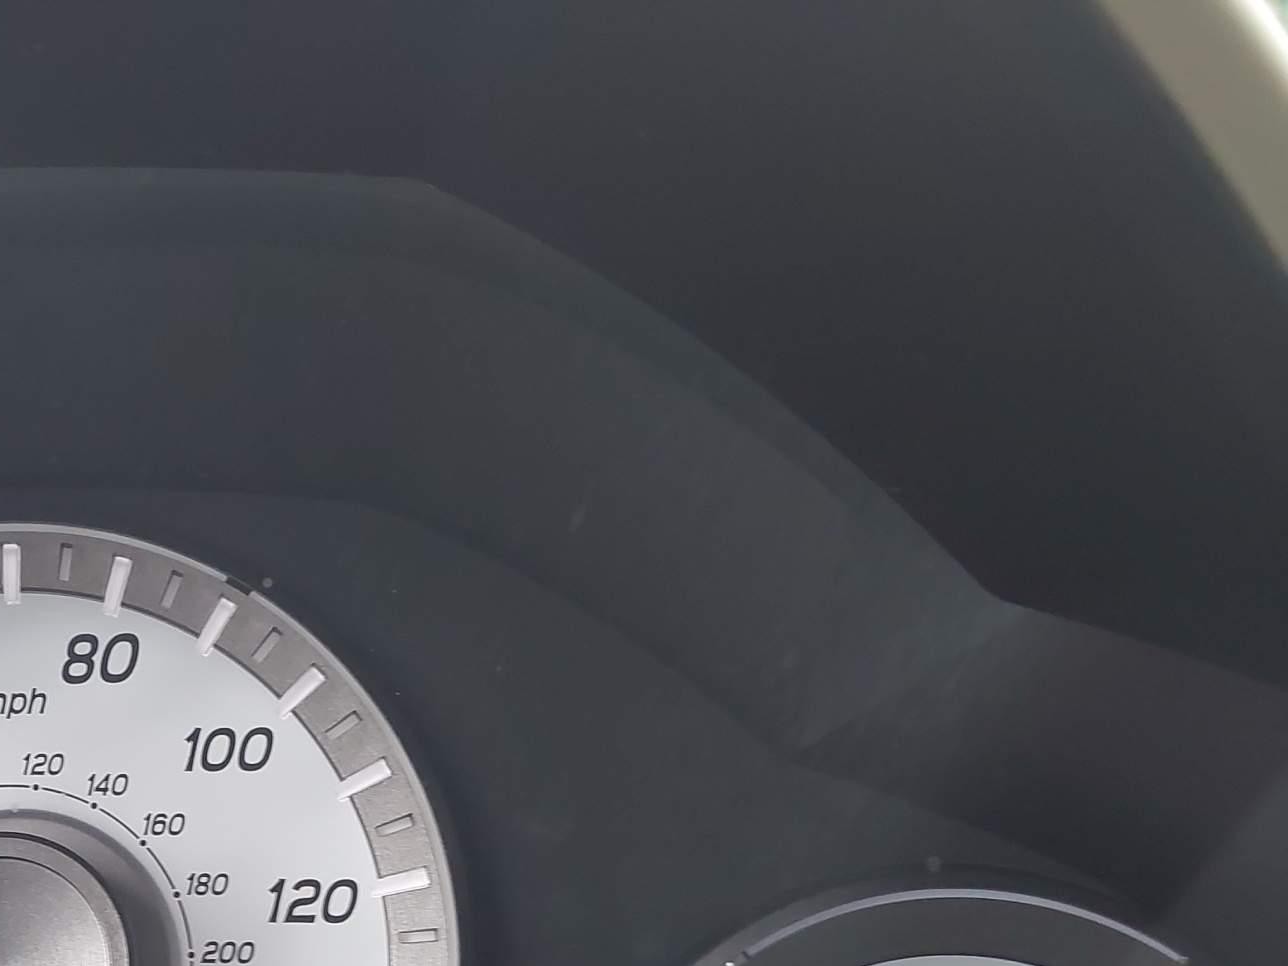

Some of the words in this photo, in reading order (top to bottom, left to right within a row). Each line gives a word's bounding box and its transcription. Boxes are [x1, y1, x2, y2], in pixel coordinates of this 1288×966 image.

[62, 633, 140, 684] 80
[184, 727, 274, 772] 100
[23, 753, 64, 776] 120
[87, 773, 129, 796] 140
[143, 813, 185, 836] 160
[186, 873, 229, 896] 180
[267, 878, 358, 924] 120
[200, 941, 255, 964] 200
